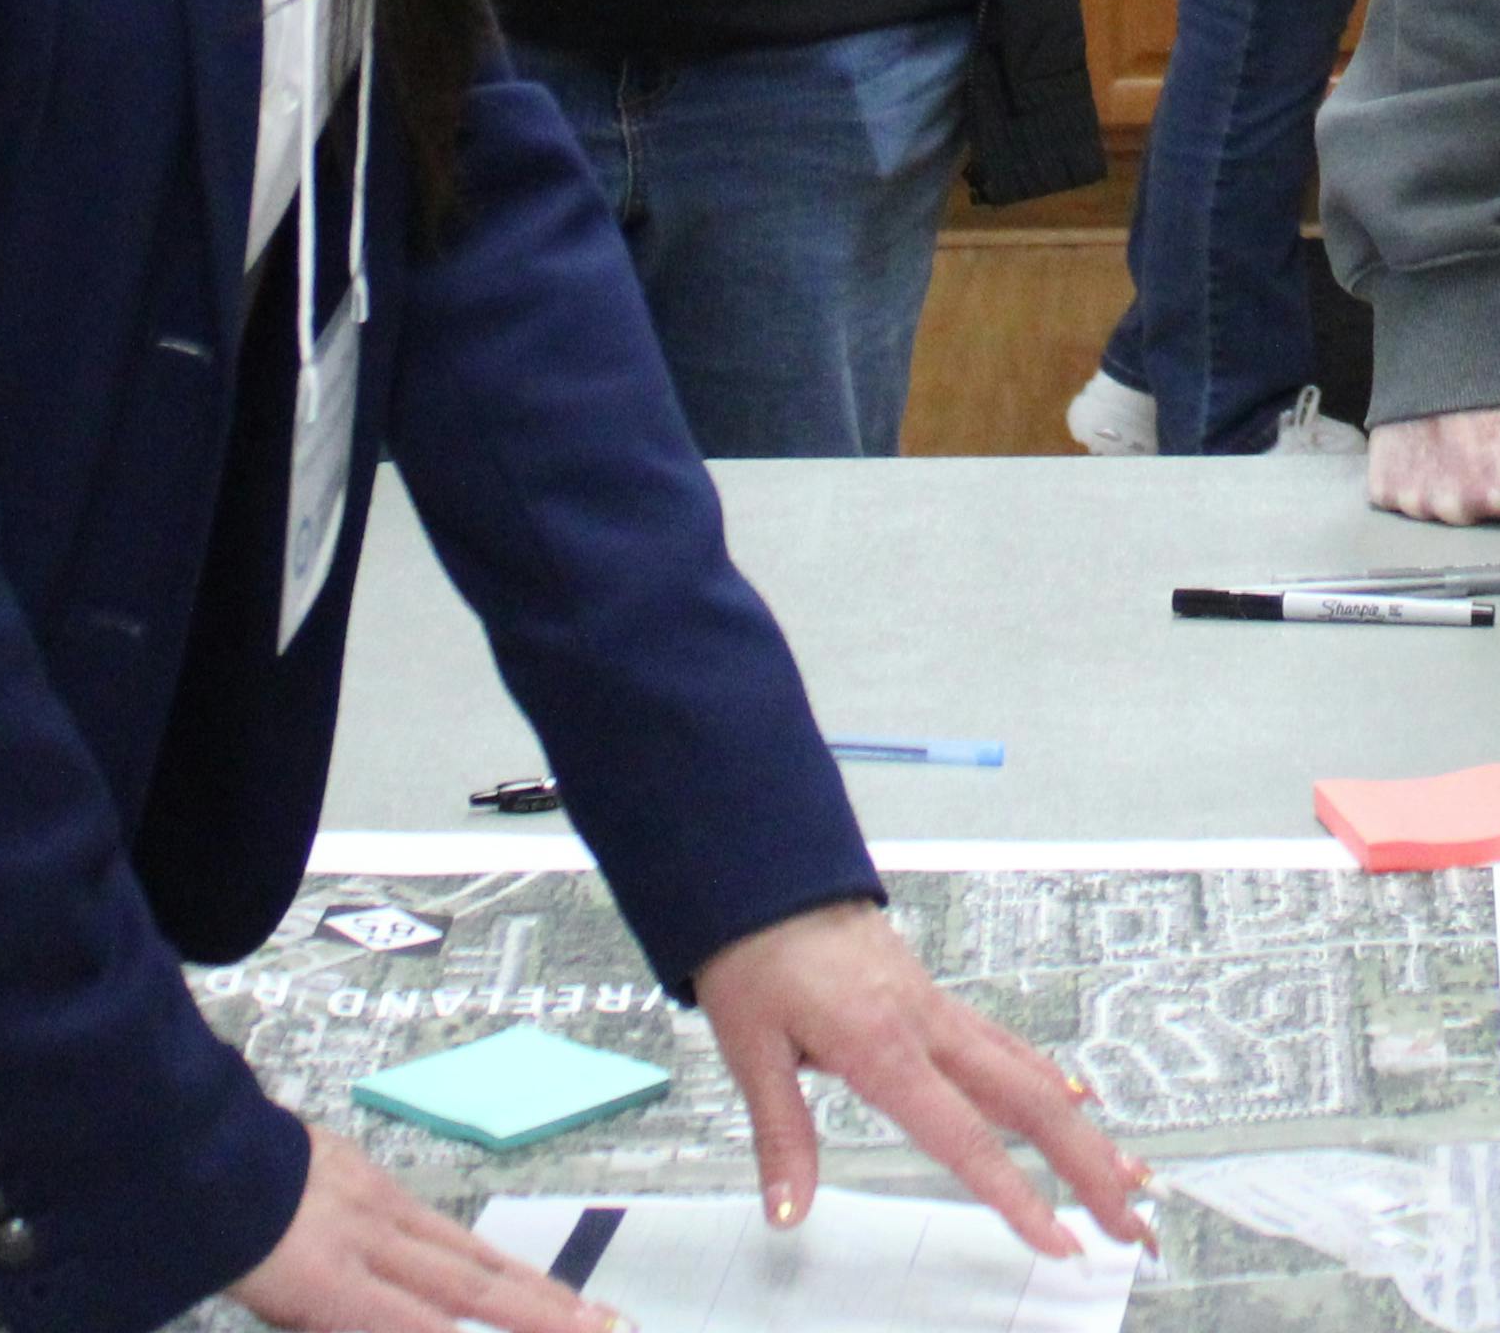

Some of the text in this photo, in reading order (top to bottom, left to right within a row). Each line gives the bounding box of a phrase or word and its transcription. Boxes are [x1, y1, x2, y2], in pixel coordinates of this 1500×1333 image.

[1319, 598, 1384, 620] Sharpie
[202, 965, 681, 1019] VREELAND RD
